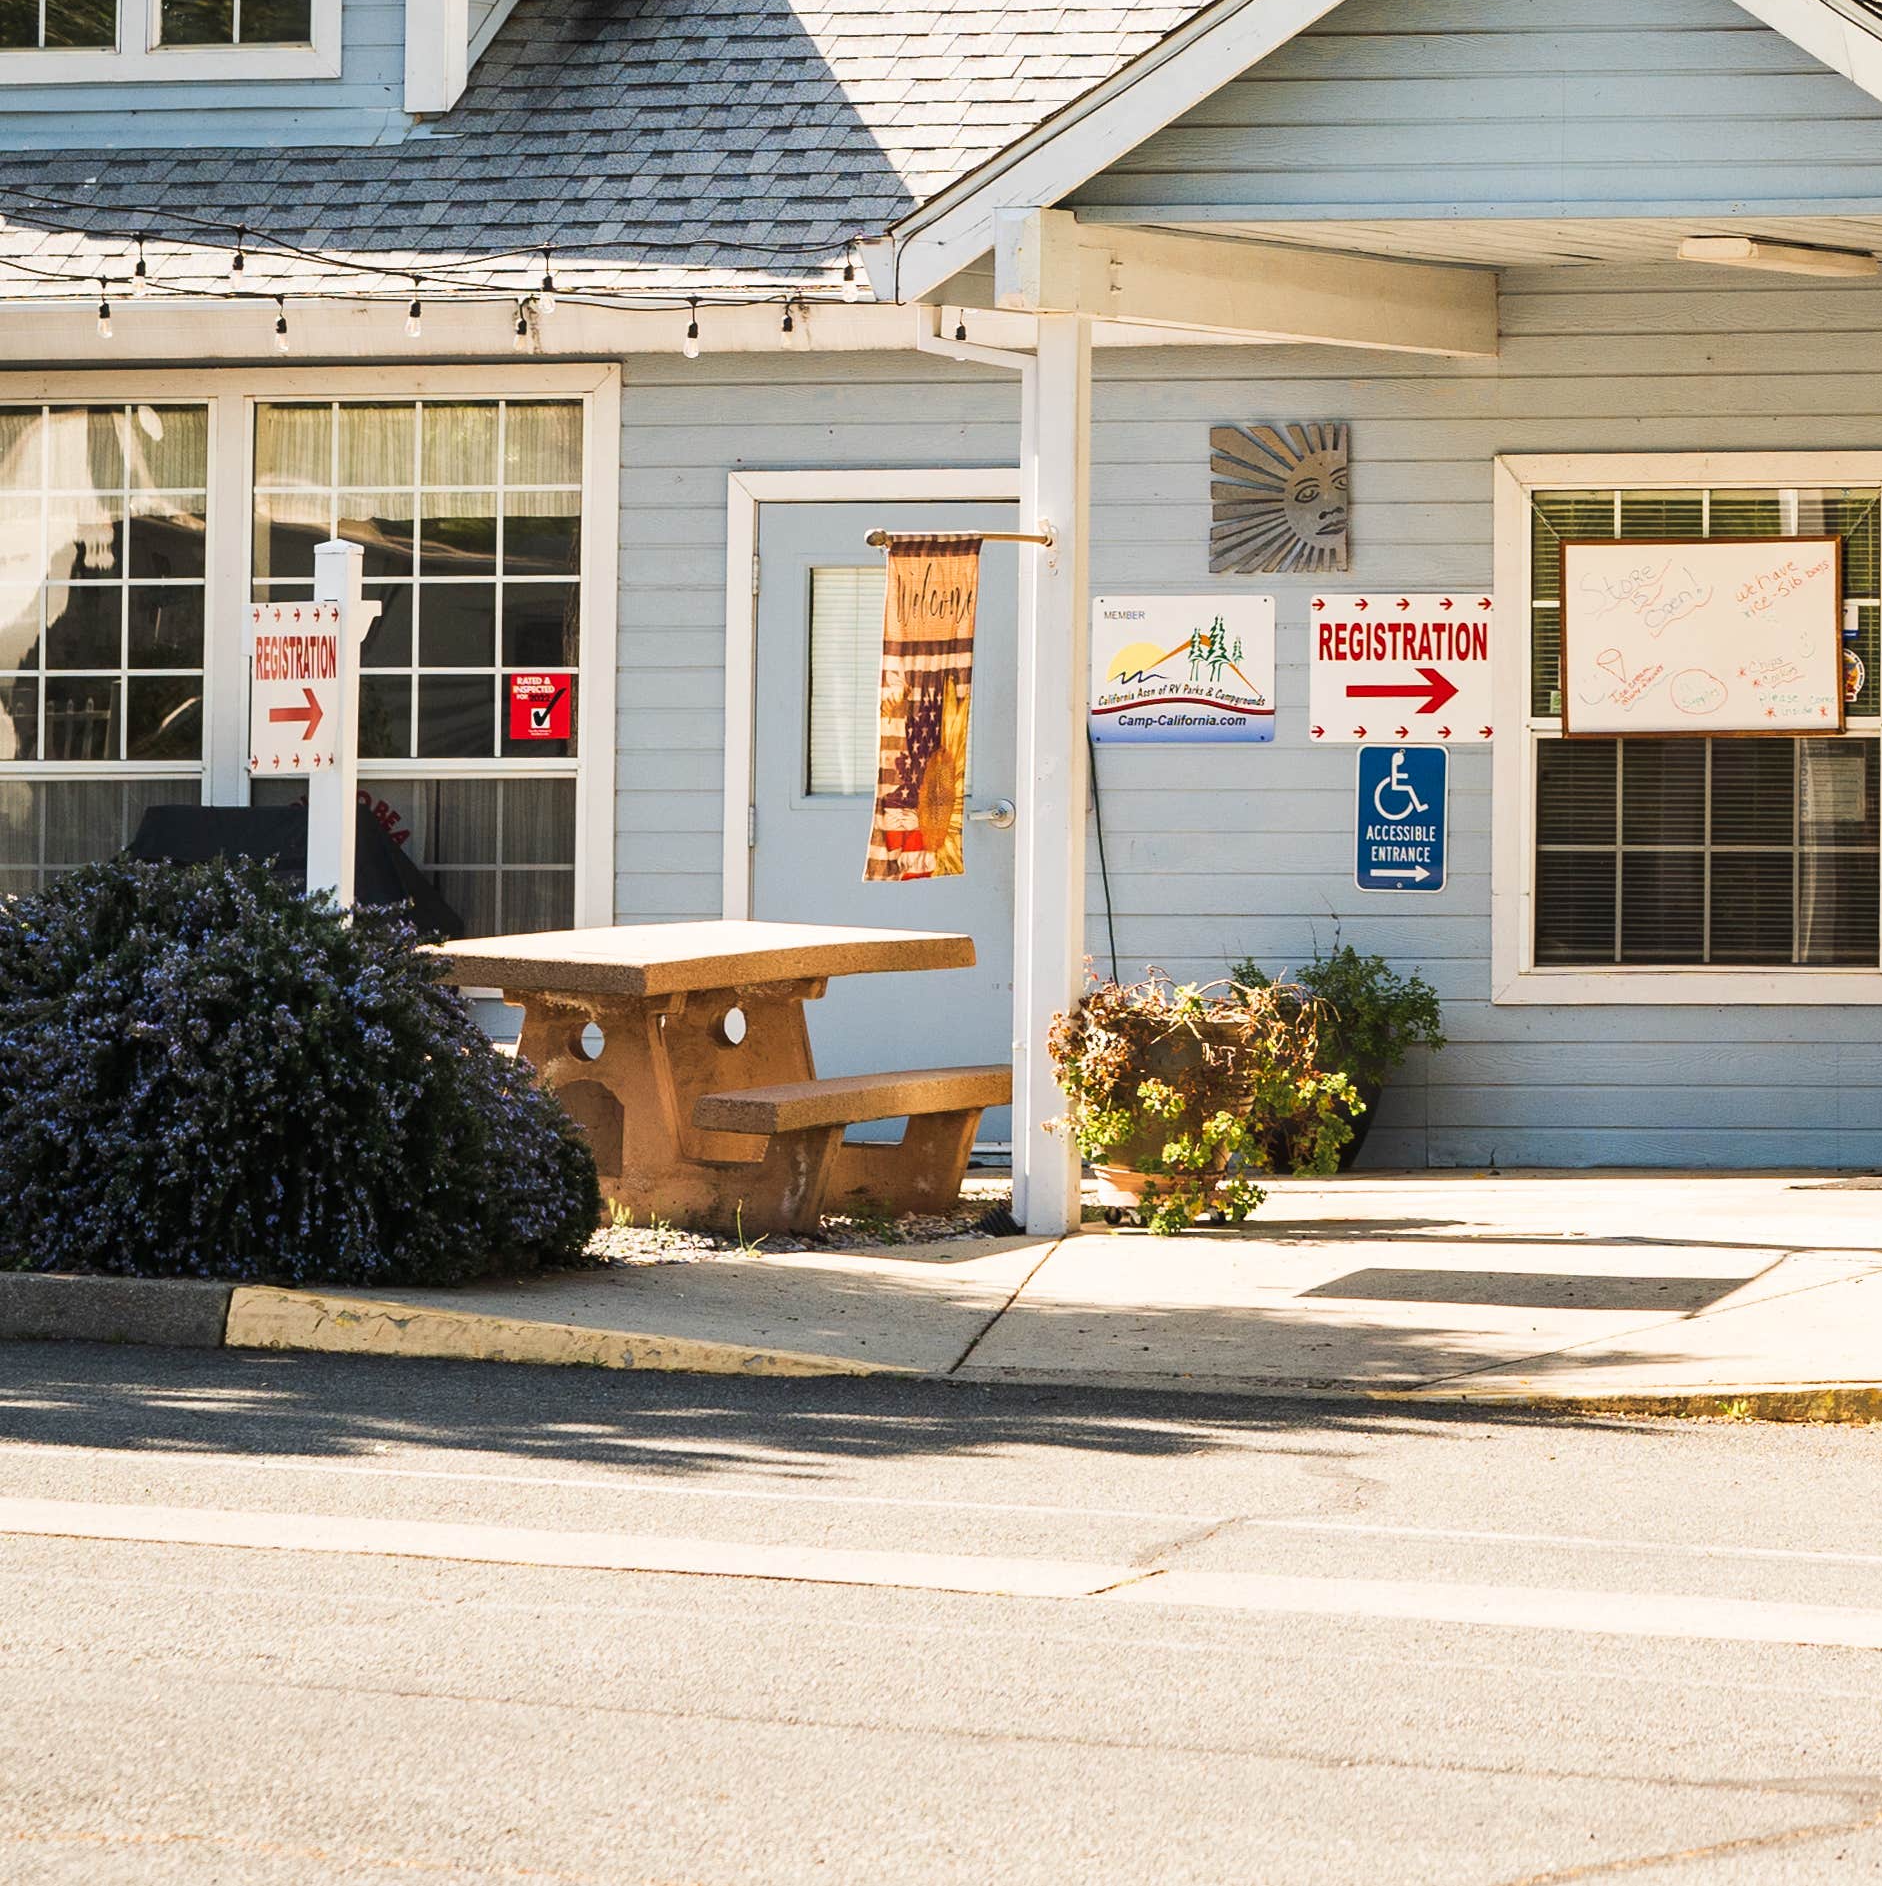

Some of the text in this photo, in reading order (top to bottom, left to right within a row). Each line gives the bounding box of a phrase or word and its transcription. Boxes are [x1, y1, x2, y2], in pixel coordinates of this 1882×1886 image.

[897, 563, 973, 626] Welcome
[1104, 611, 1145, 620] MEMBER
[1319, 622, 1487, 661] REGISTRATION
[256, 635, 336, 680] REGISTRATION
[1099, 684, 1266, 707] California Assn of RV Parks & Campgrounds
[1118, 715, 1247, 728] Camp-California.com
[1366, 825, 1436, 842] ACCESSIBLE
[1371, 846, 1431, 863] ENTRANCE
